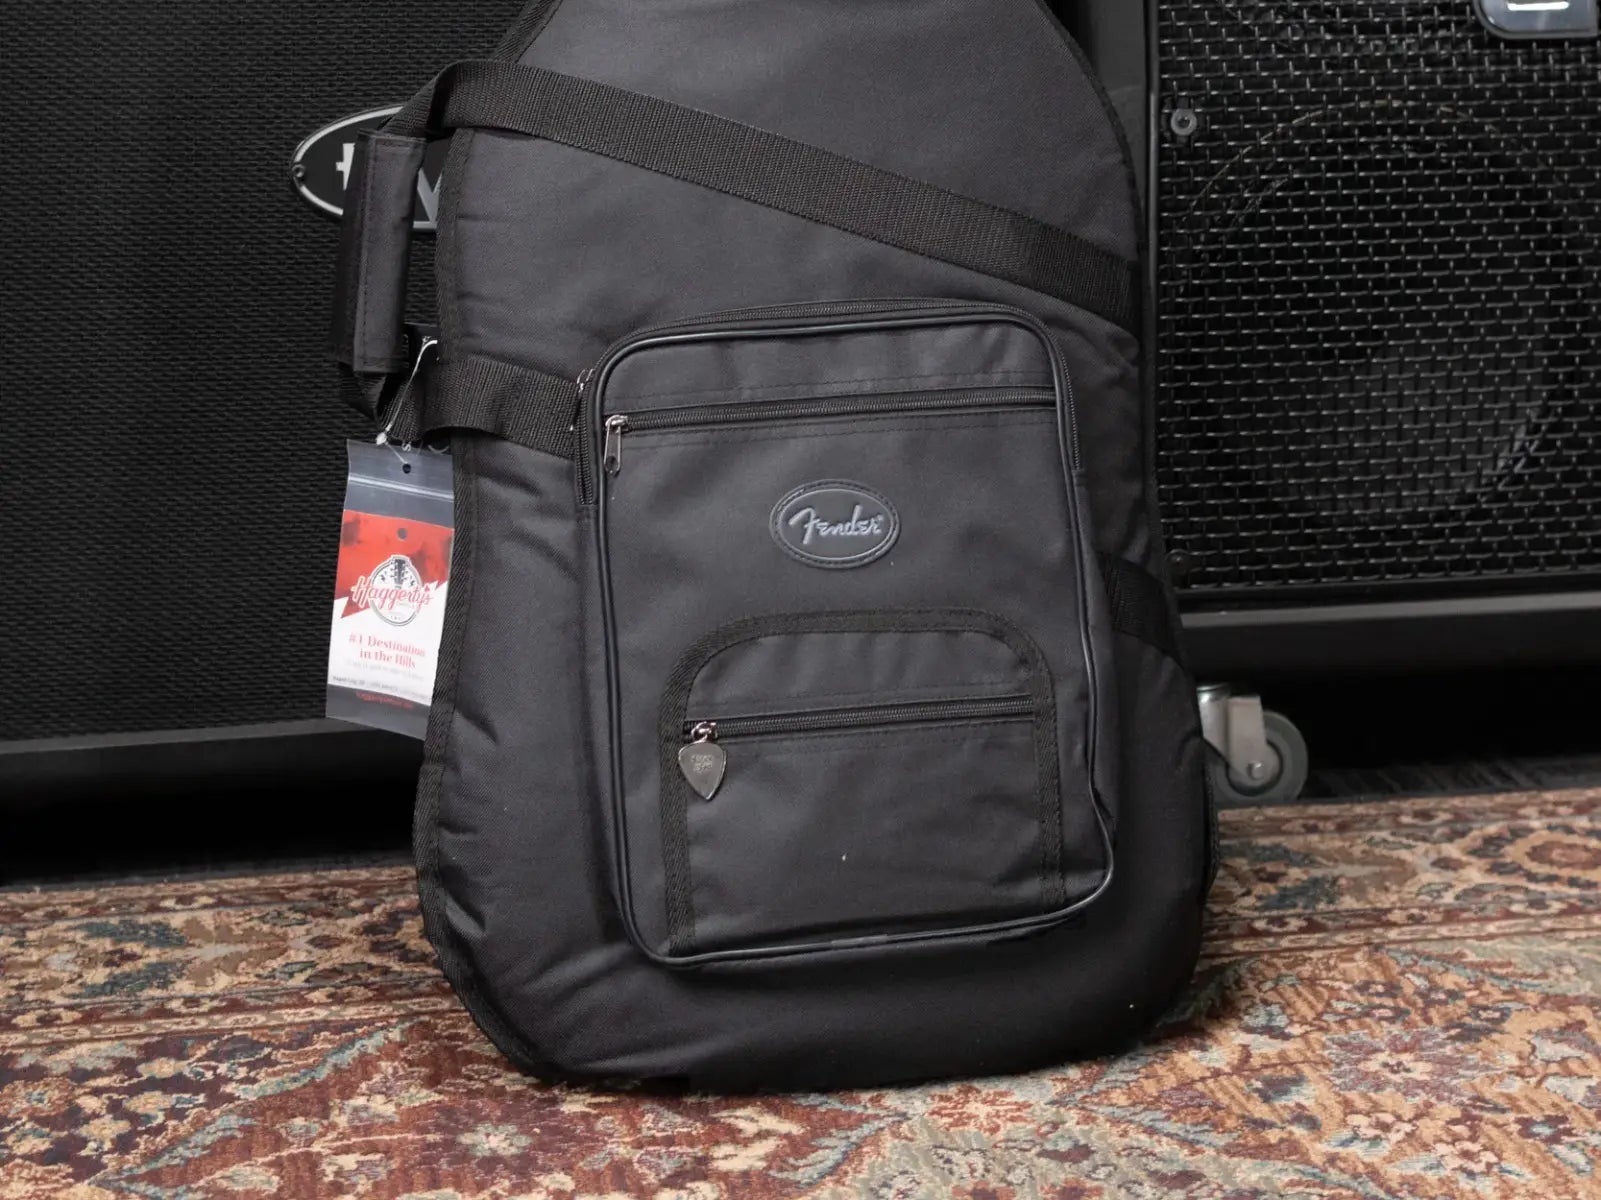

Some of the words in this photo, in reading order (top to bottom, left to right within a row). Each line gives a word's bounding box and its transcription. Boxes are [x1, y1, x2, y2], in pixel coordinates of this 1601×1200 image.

[788, 504, 882, 545] Fender
[359, 648, 372, 659] in
[374, 650, 393, 663] the
[367, 635, 426, 657] Destination
